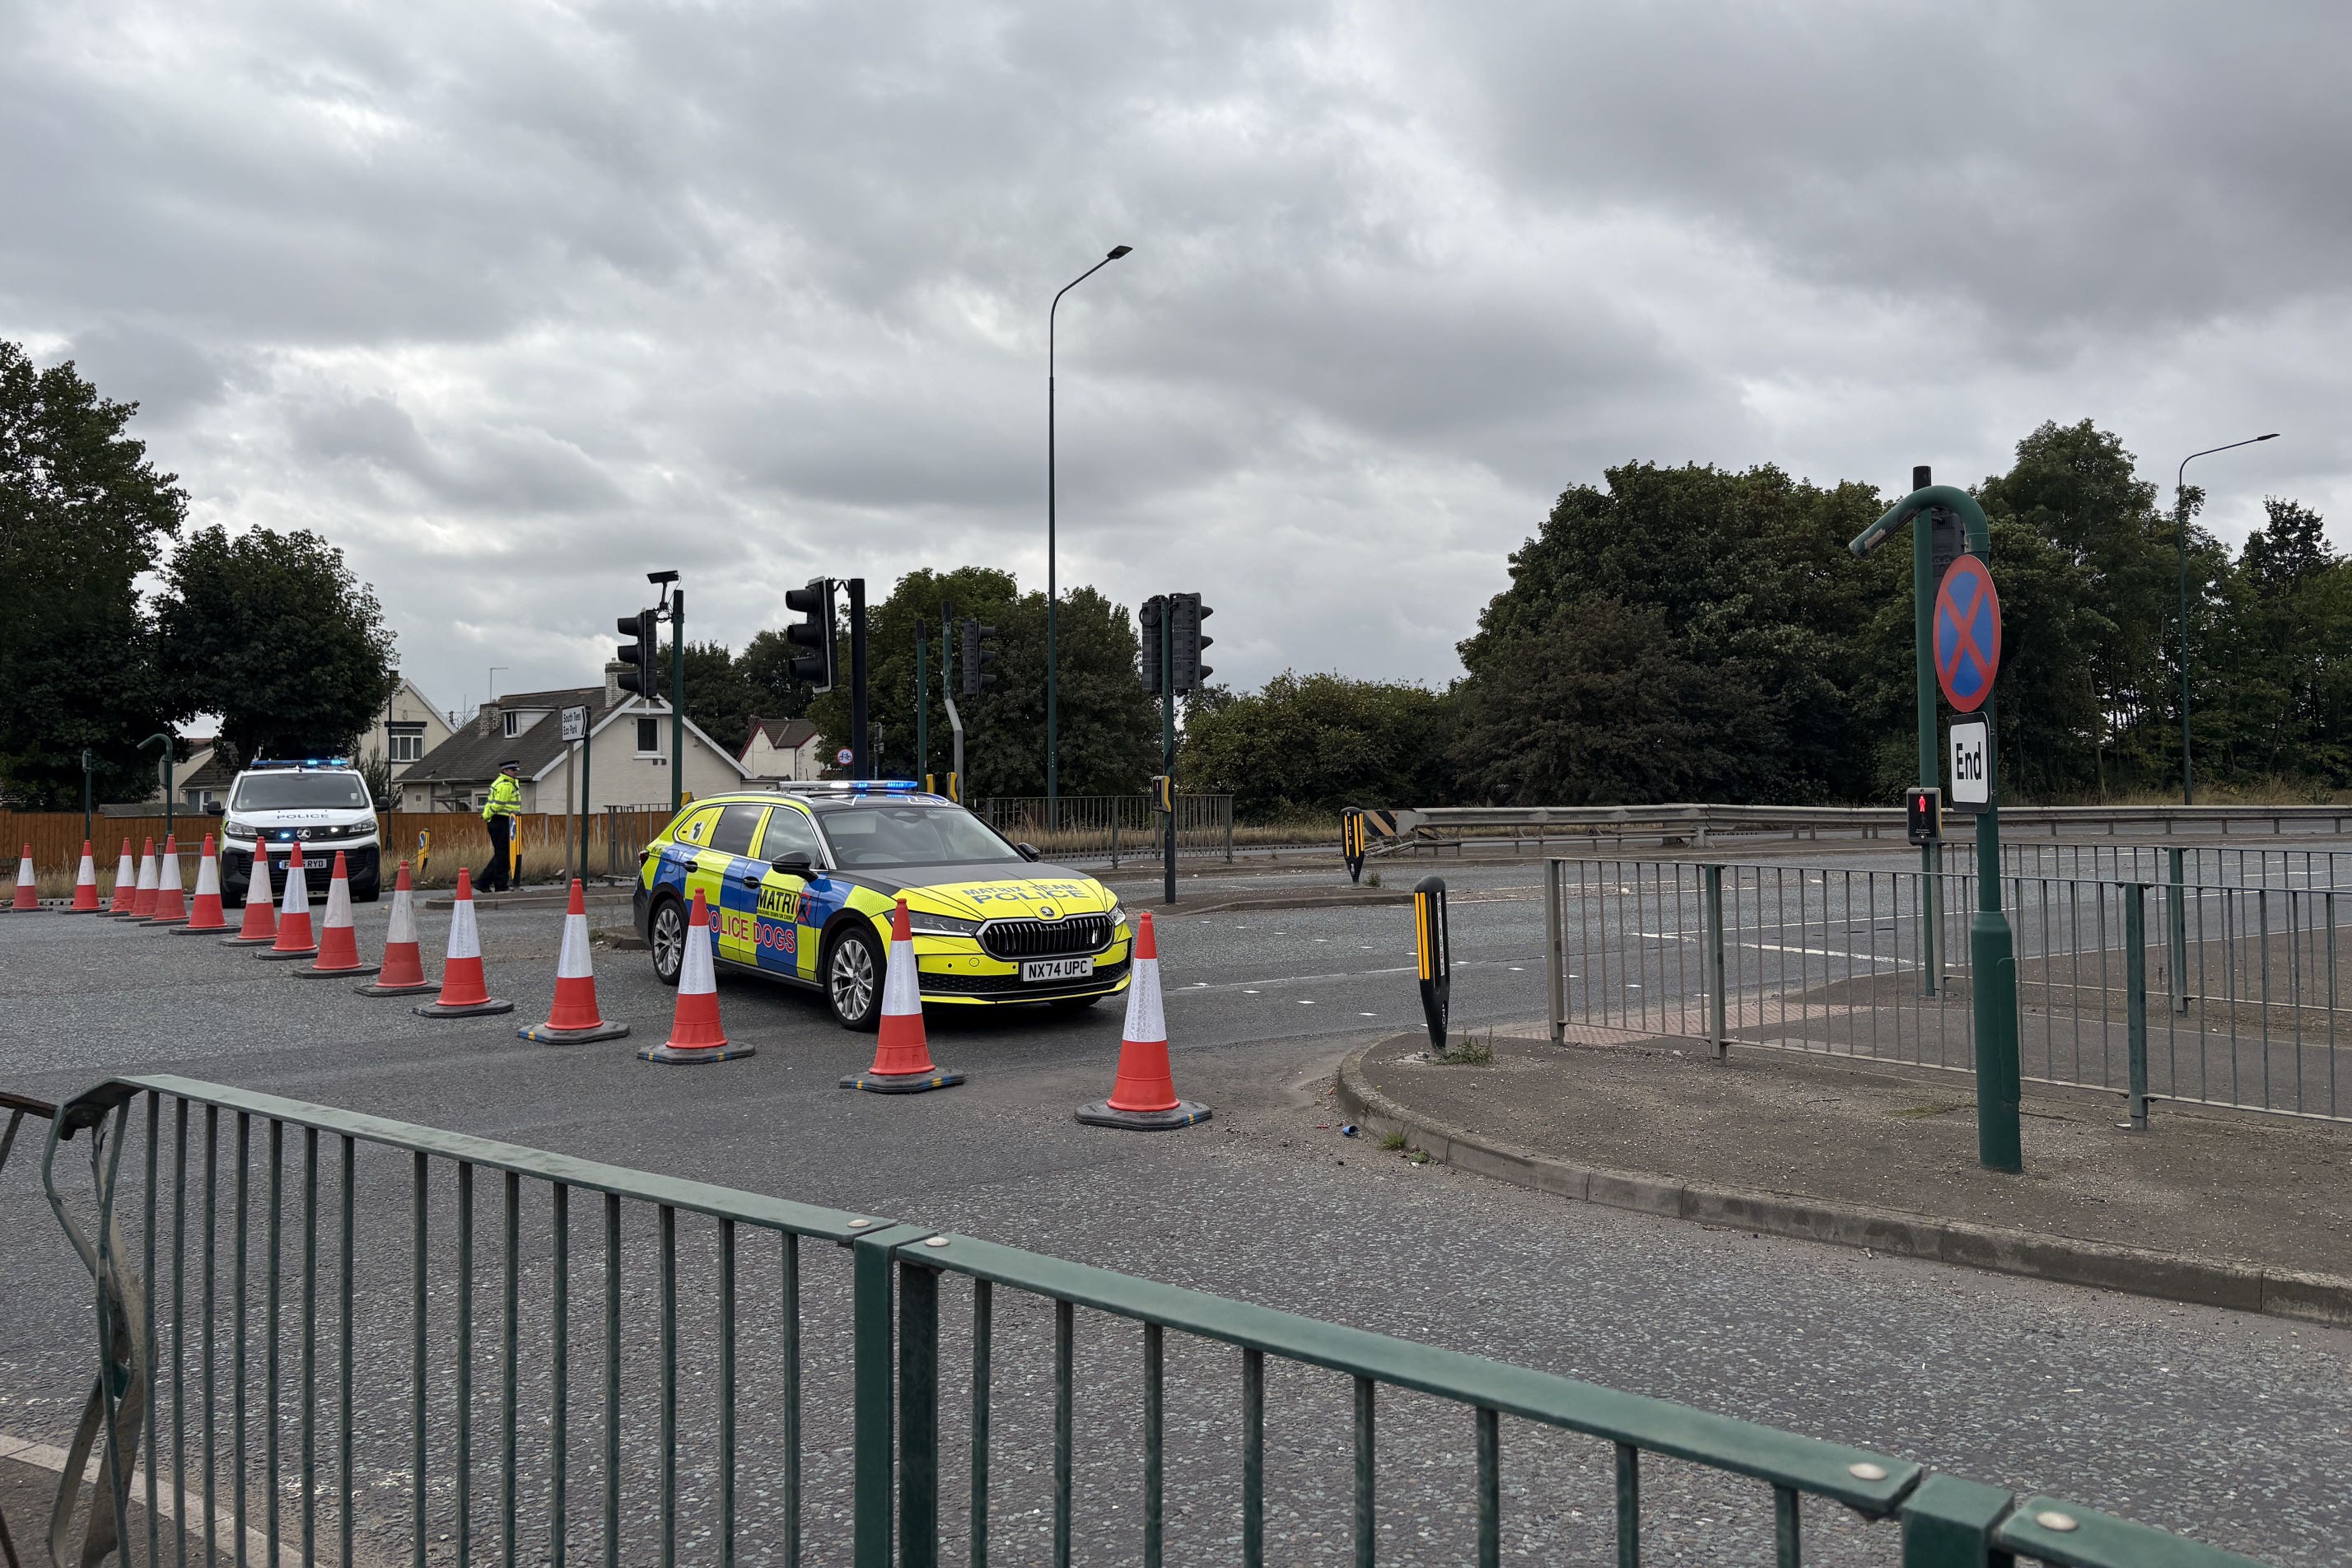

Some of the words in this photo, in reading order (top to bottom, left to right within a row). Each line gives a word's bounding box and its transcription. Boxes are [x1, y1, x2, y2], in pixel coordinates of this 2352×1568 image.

[1956, 741, 1981, 780] End
[308, 860, 324, 868] RYD
[962, 886, 1025, 896] MATRIX
[971, 889, 1091, 904] POLICE
[707, 909, 749, 941] OLICE
[753, 921, 796, 954] DOGS
[1029, 962, 1062, 978] NX74
[1065, 960, 1088, 975] UPC
